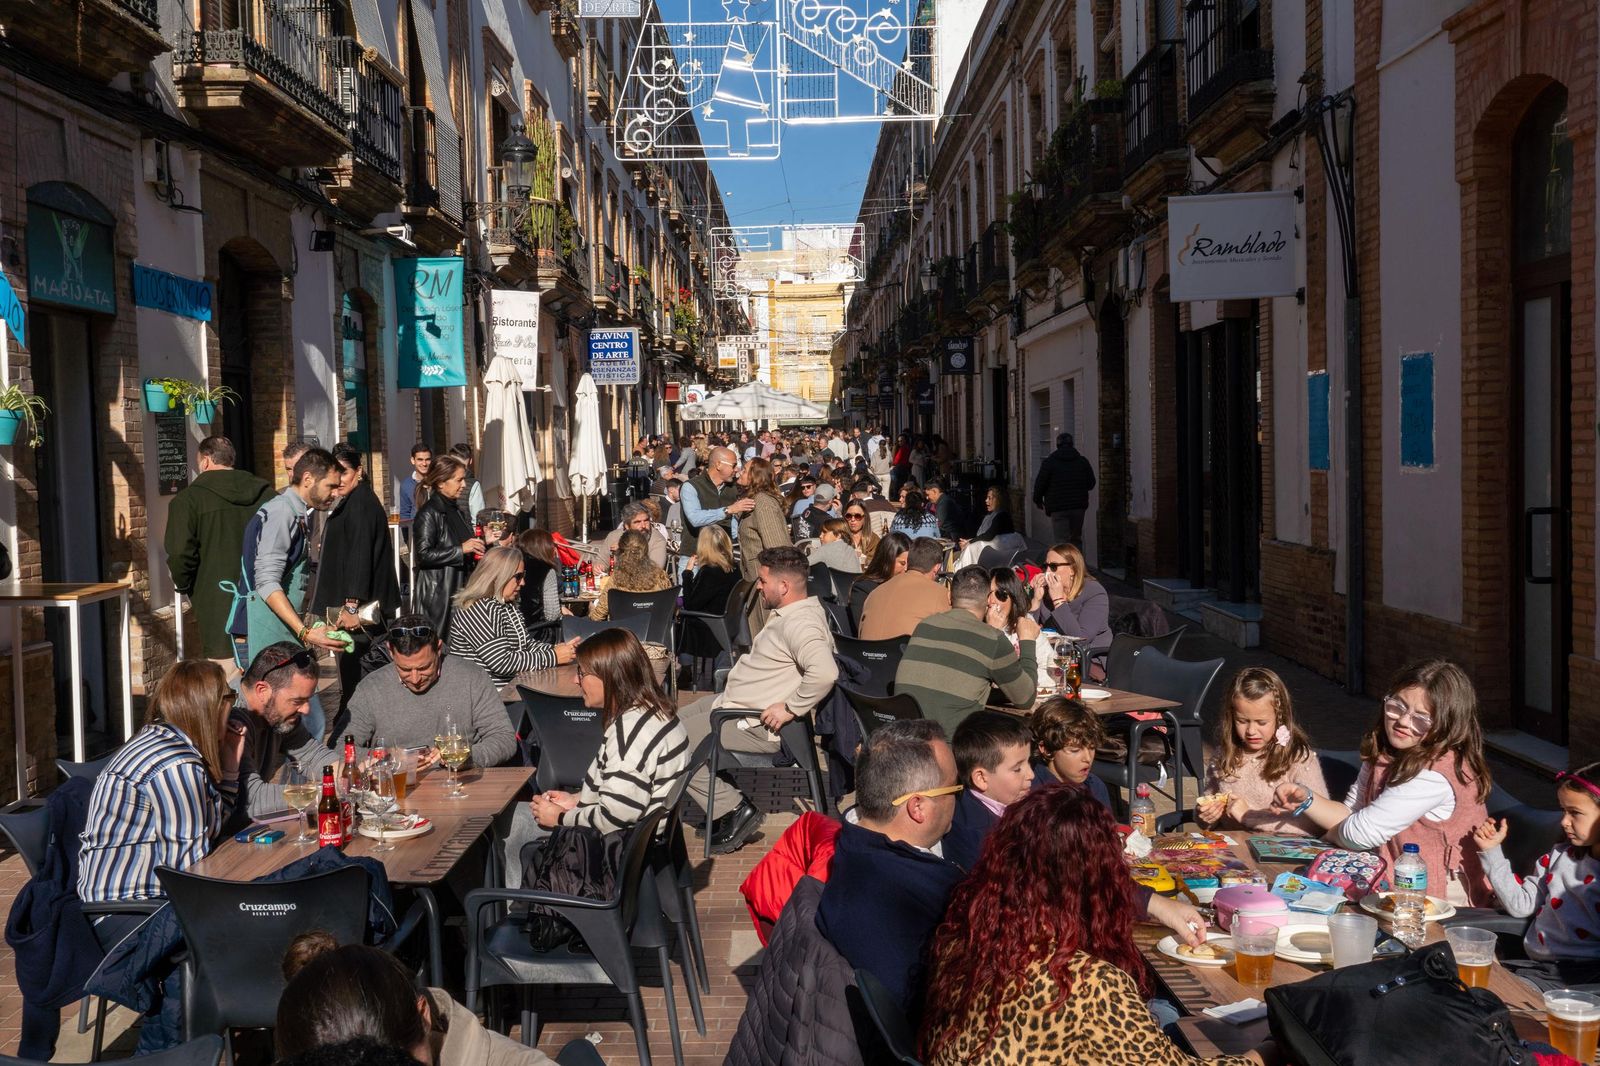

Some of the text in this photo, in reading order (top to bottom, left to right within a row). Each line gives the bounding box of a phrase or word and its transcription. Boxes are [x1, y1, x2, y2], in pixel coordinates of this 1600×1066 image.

[604, 2, 635, 13] ARTE
[1191, 230, 1286, 257] Ramblado
[408, 269, 455, 299] RM
[34, 274, 111, 305] MARIJATA
[136, 268, 211, 314] UTOSERVICIO
[492, 316, 537, 328] Ristorante
[590, 332, 630, 341] GRAVINA
[592, 341, 628, 350] CENTRO
[606, 351, 629, 360] ARTE
[512, 356, 533, 366] eria
[563, 710, 598, 718] Cruzcampo
[239, 902, 298, 912] Cruzcampo
